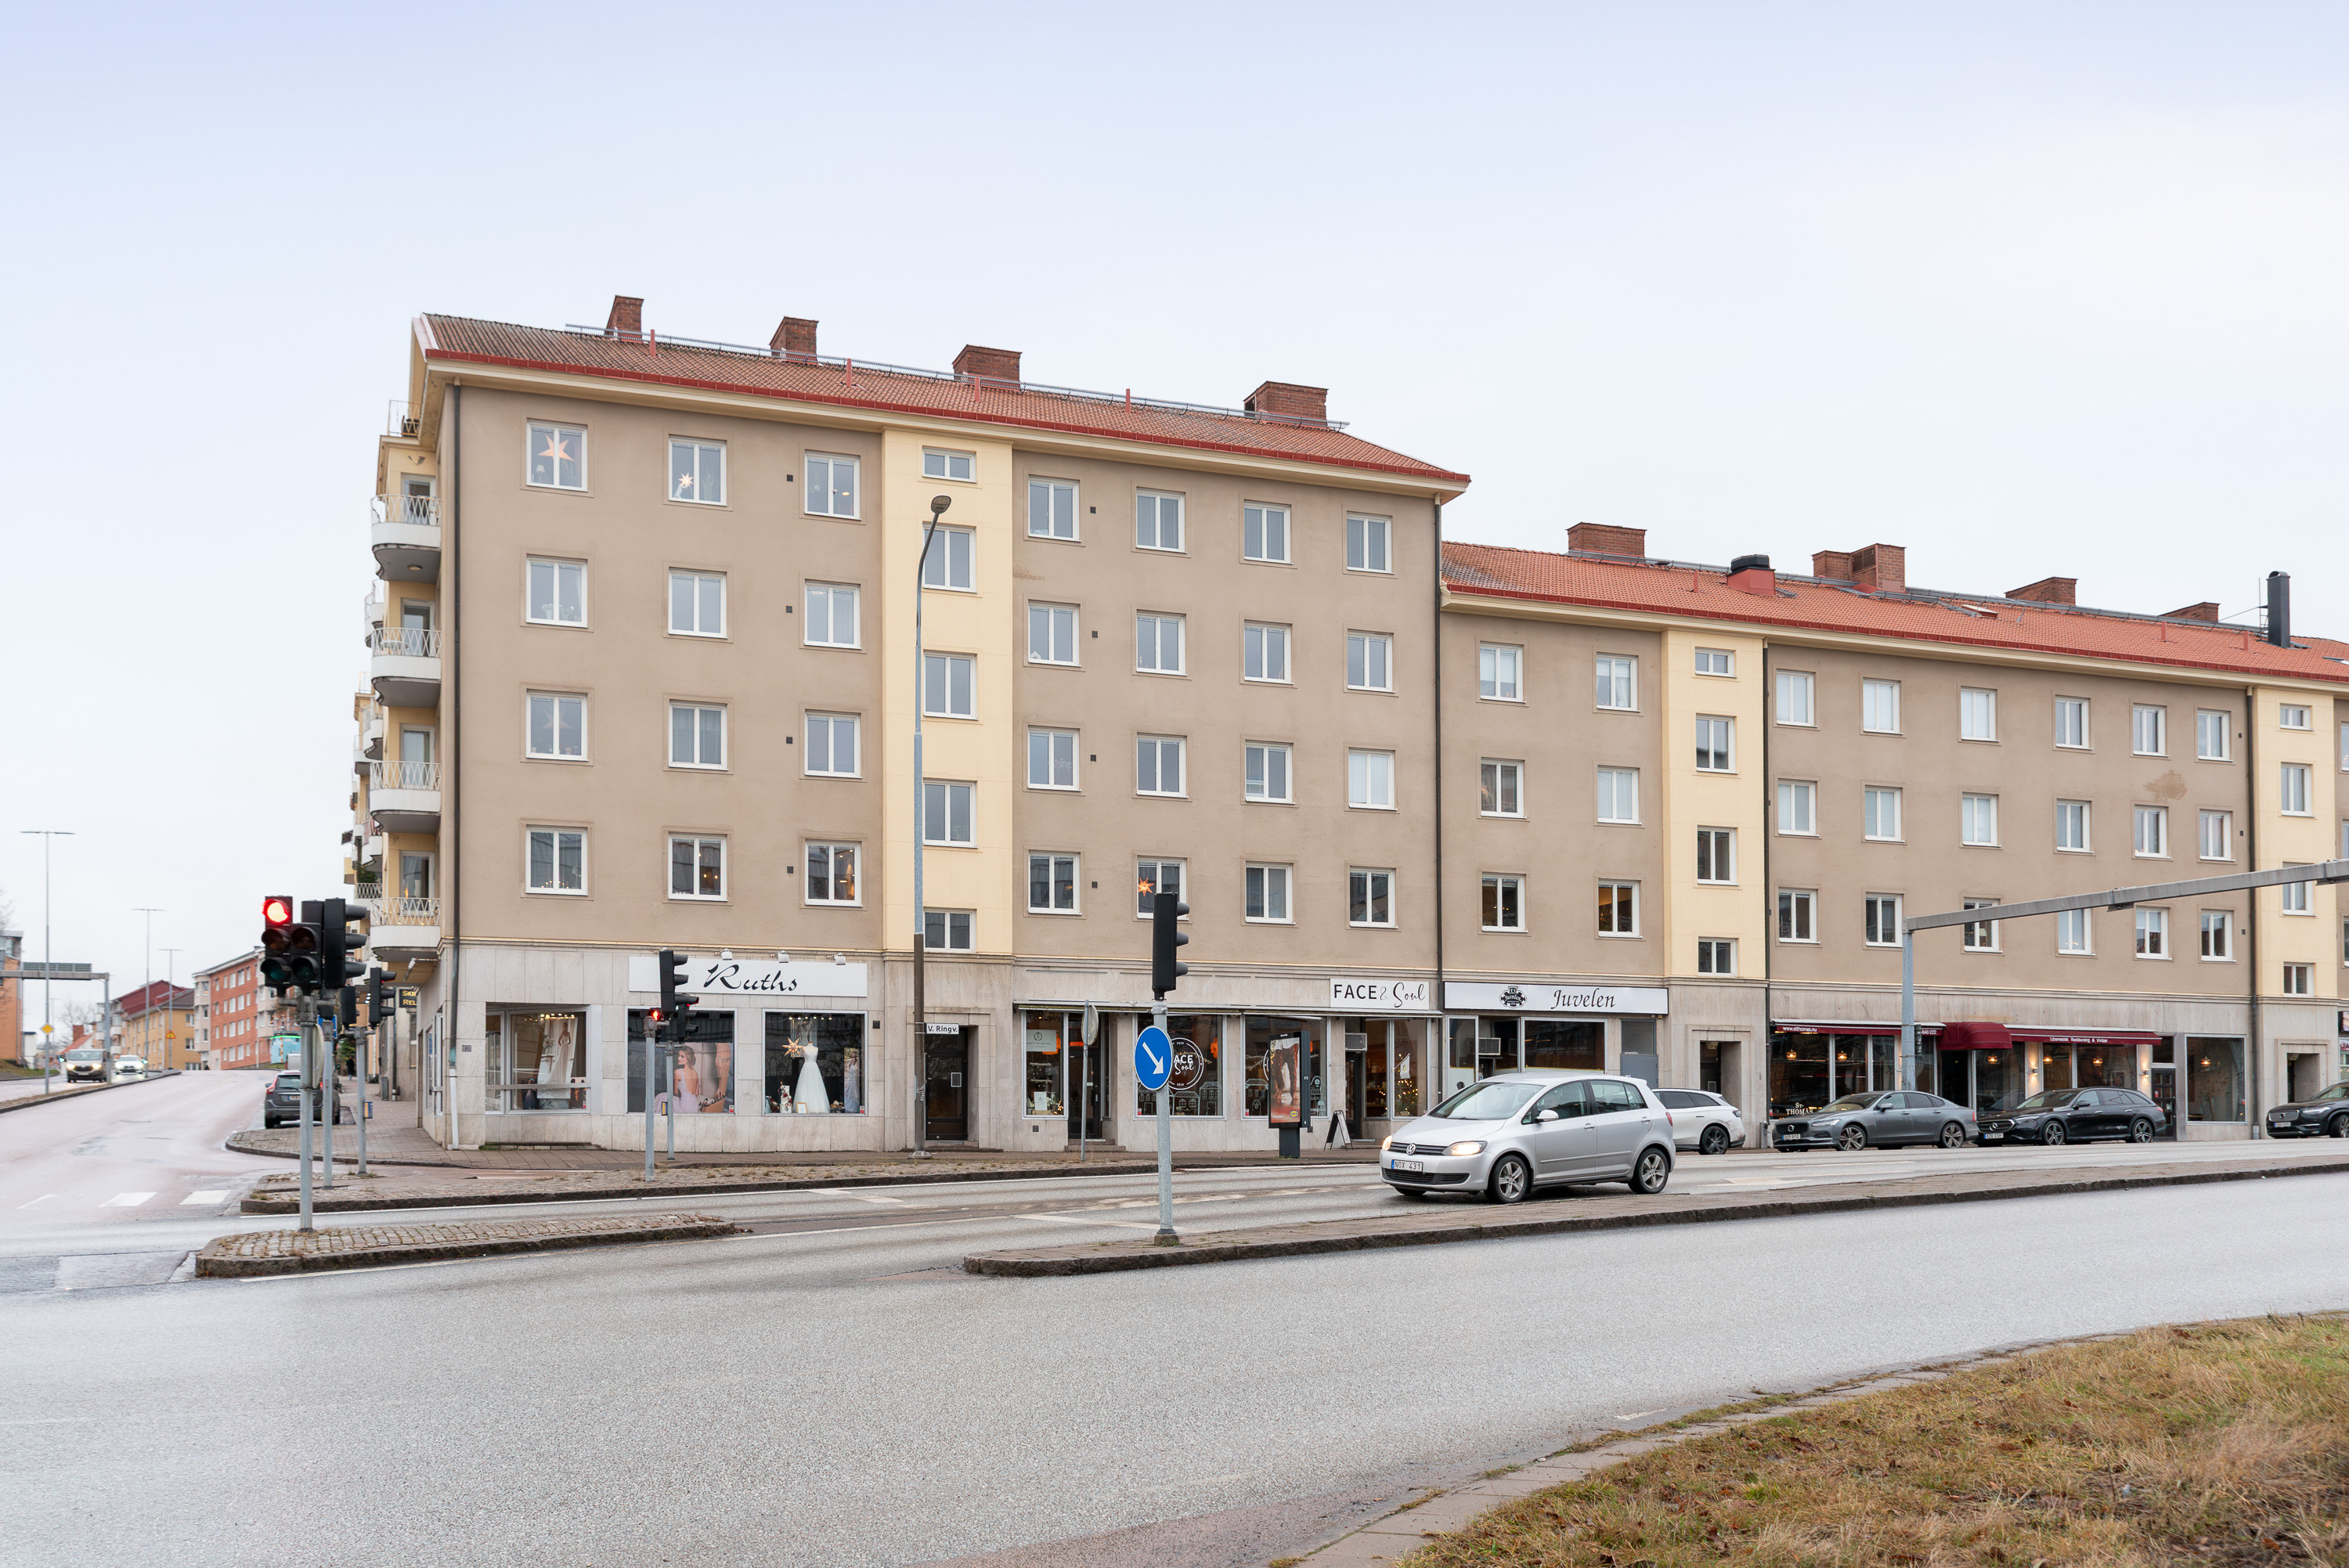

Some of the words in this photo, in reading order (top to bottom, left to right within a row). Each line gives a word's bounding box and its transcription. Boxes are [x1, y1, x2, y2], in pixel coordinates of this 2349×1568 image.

[703, 964, 797, 991] Ruths
[1333, 984, 1377, 1000] FACE
[1380, 986, 1390, 1000] &
[1393, 982, 1426, 1008] Soul
[1550, 988, 1615, 1009] Juvelen
[1174, 1054, 1193, 1064] ACE
